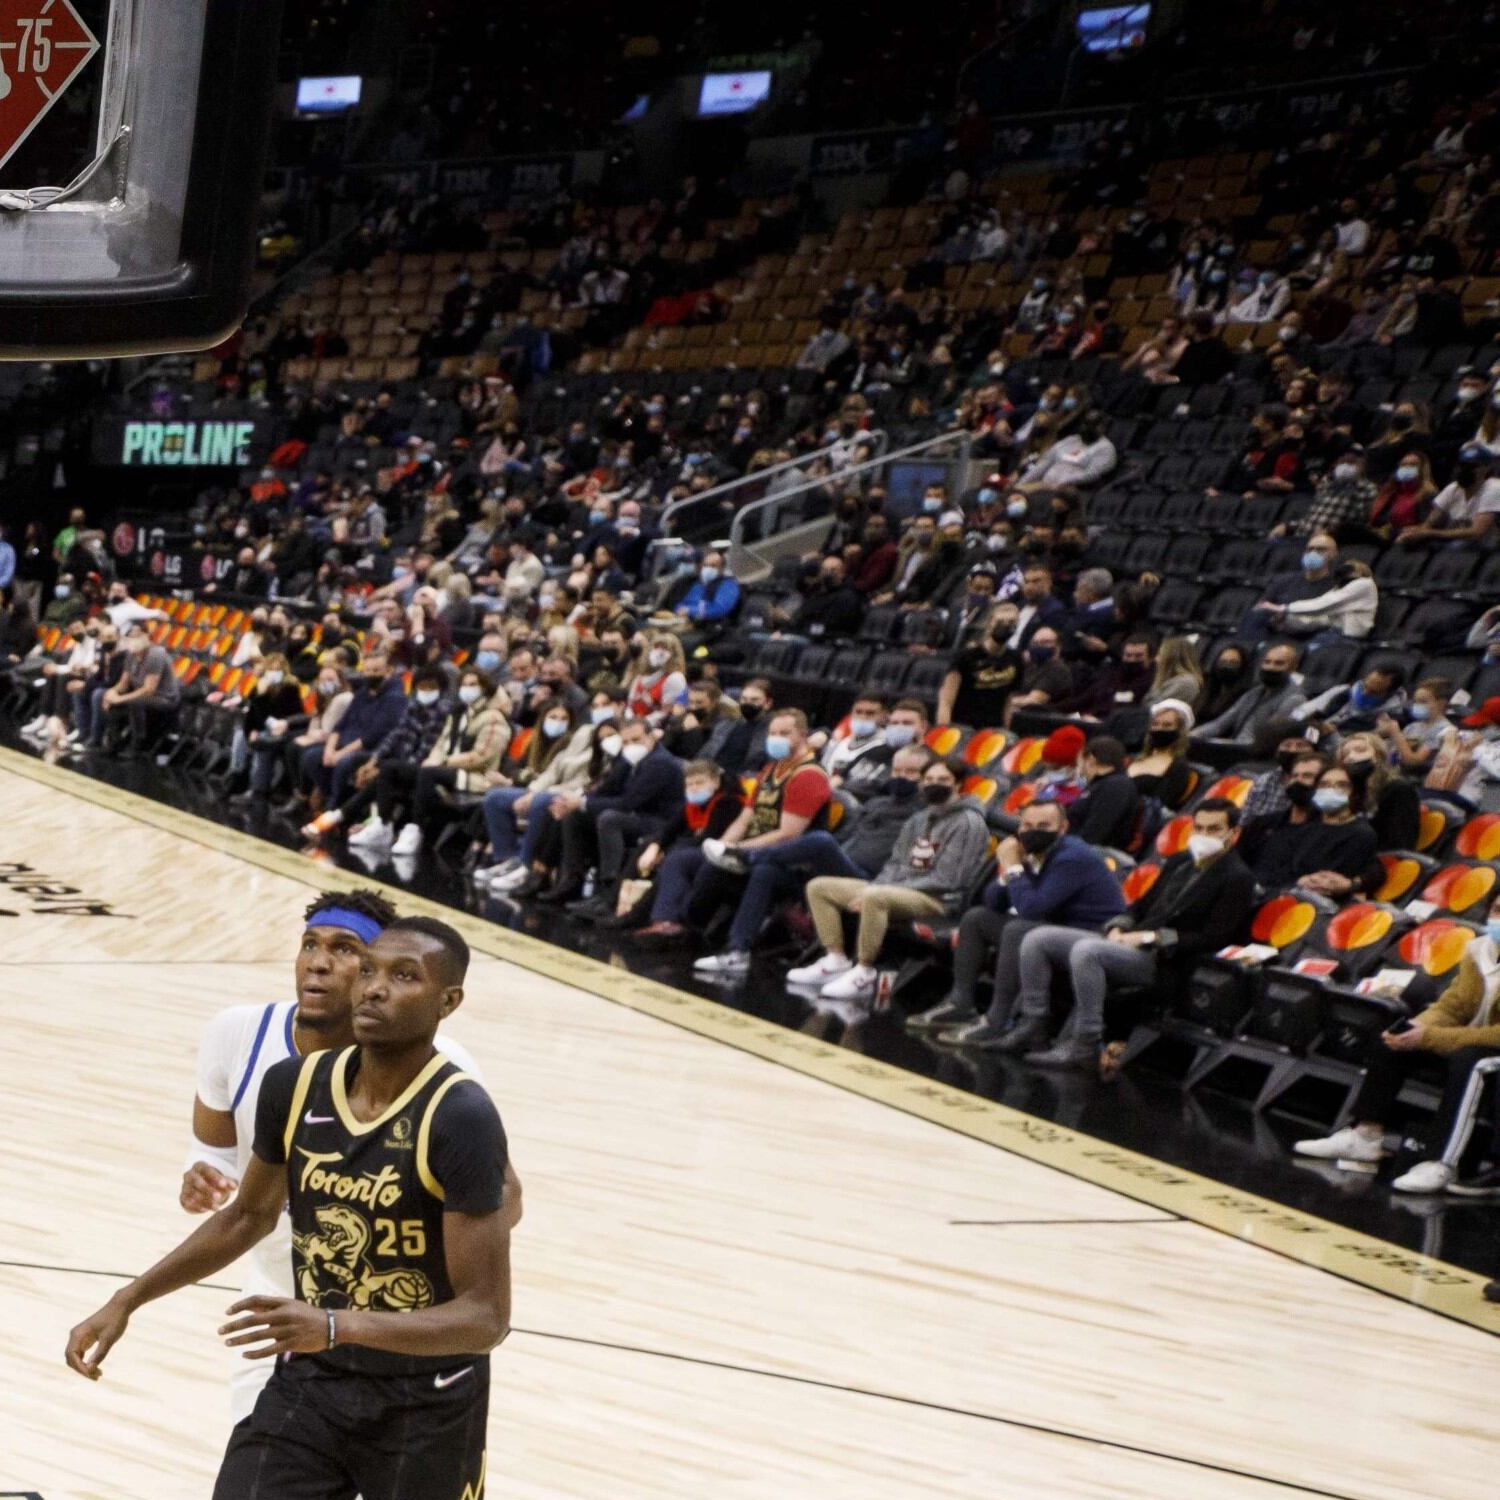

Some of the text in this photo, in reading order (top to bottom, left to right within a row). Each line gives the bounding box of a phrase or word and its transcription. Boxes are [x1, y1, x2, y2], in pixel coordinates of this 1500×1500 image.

[16, 18, 54, 73] 75
[122, 421, 254, 464] PROLINE
[295, 1145, 403, 1211] Toronto
[375, 1217, 427, 1258] 25
